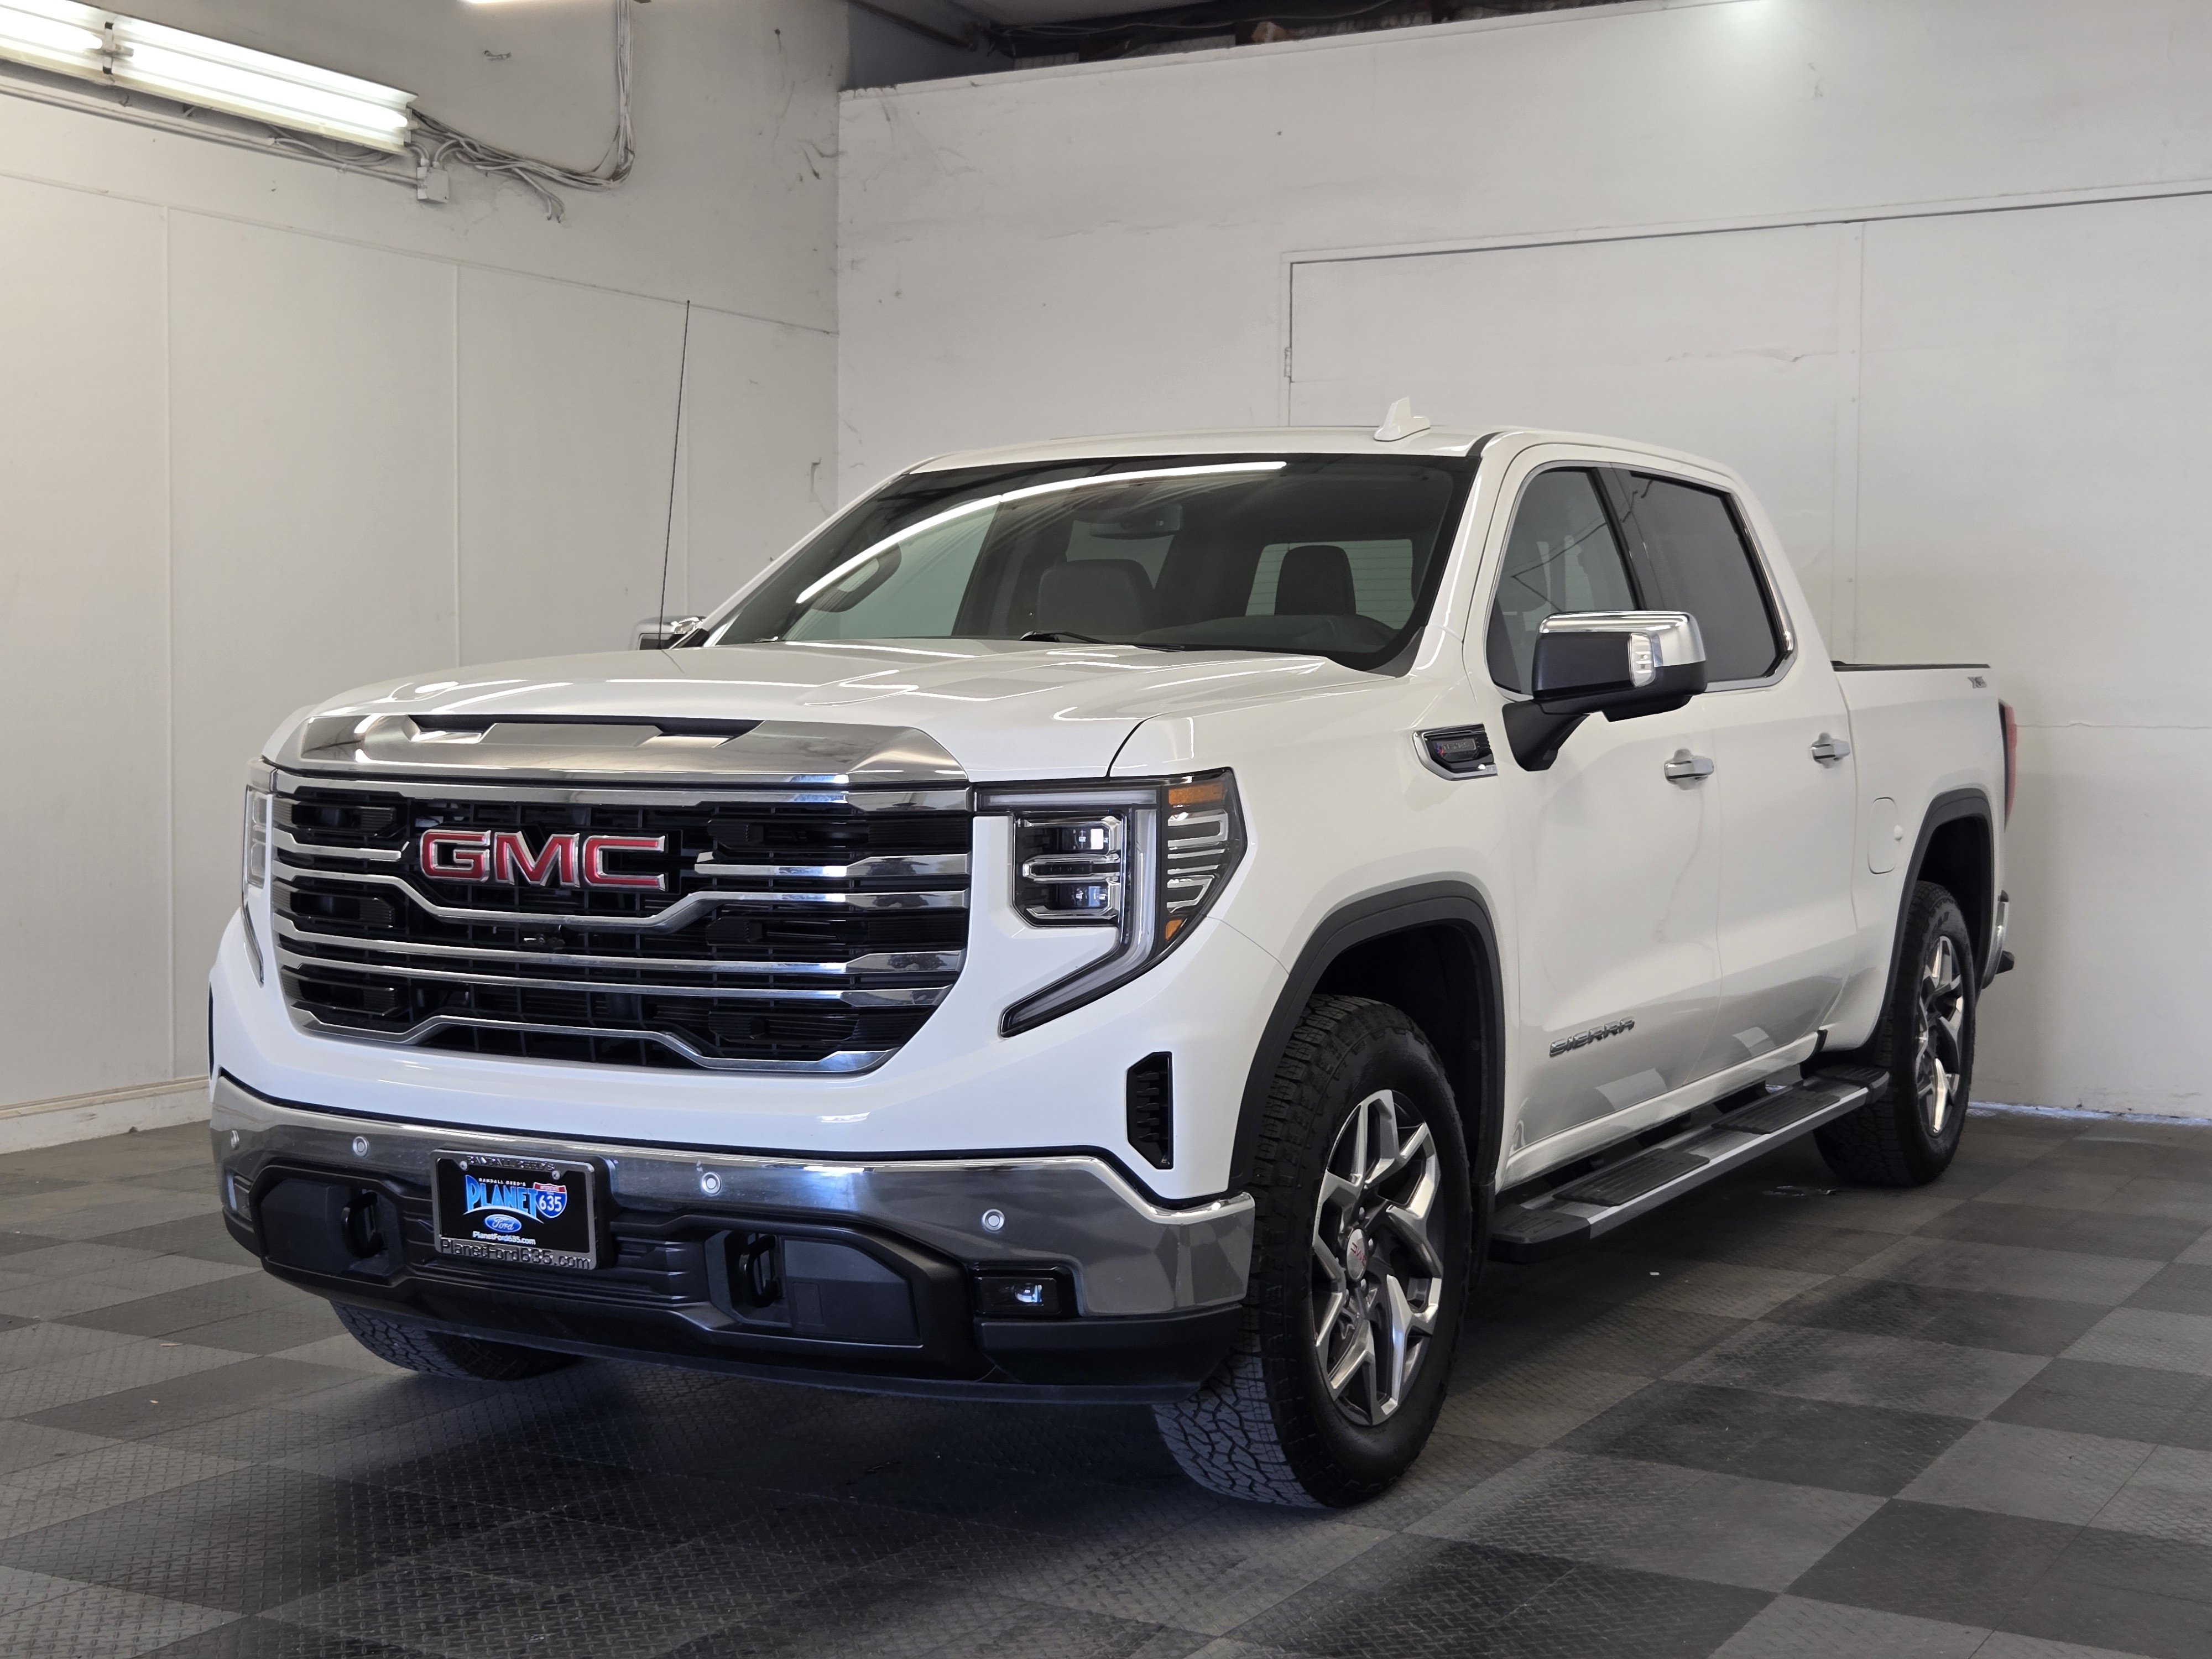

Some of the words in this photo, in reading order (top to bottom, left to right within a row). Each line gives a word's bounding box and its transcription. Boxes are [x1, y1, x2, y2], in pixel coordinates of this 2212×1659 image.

[420, 829, 666, 891] GMC
[1550, 1016, 1635, 1057] SIERRA
[465, 1175, 538, 1218] PLANET
[539, 1194, 562, 1212] 635
[492, 1217, 515, 1230] Ford
[441, 1239, 590, 1269] PlanetFord635.com
